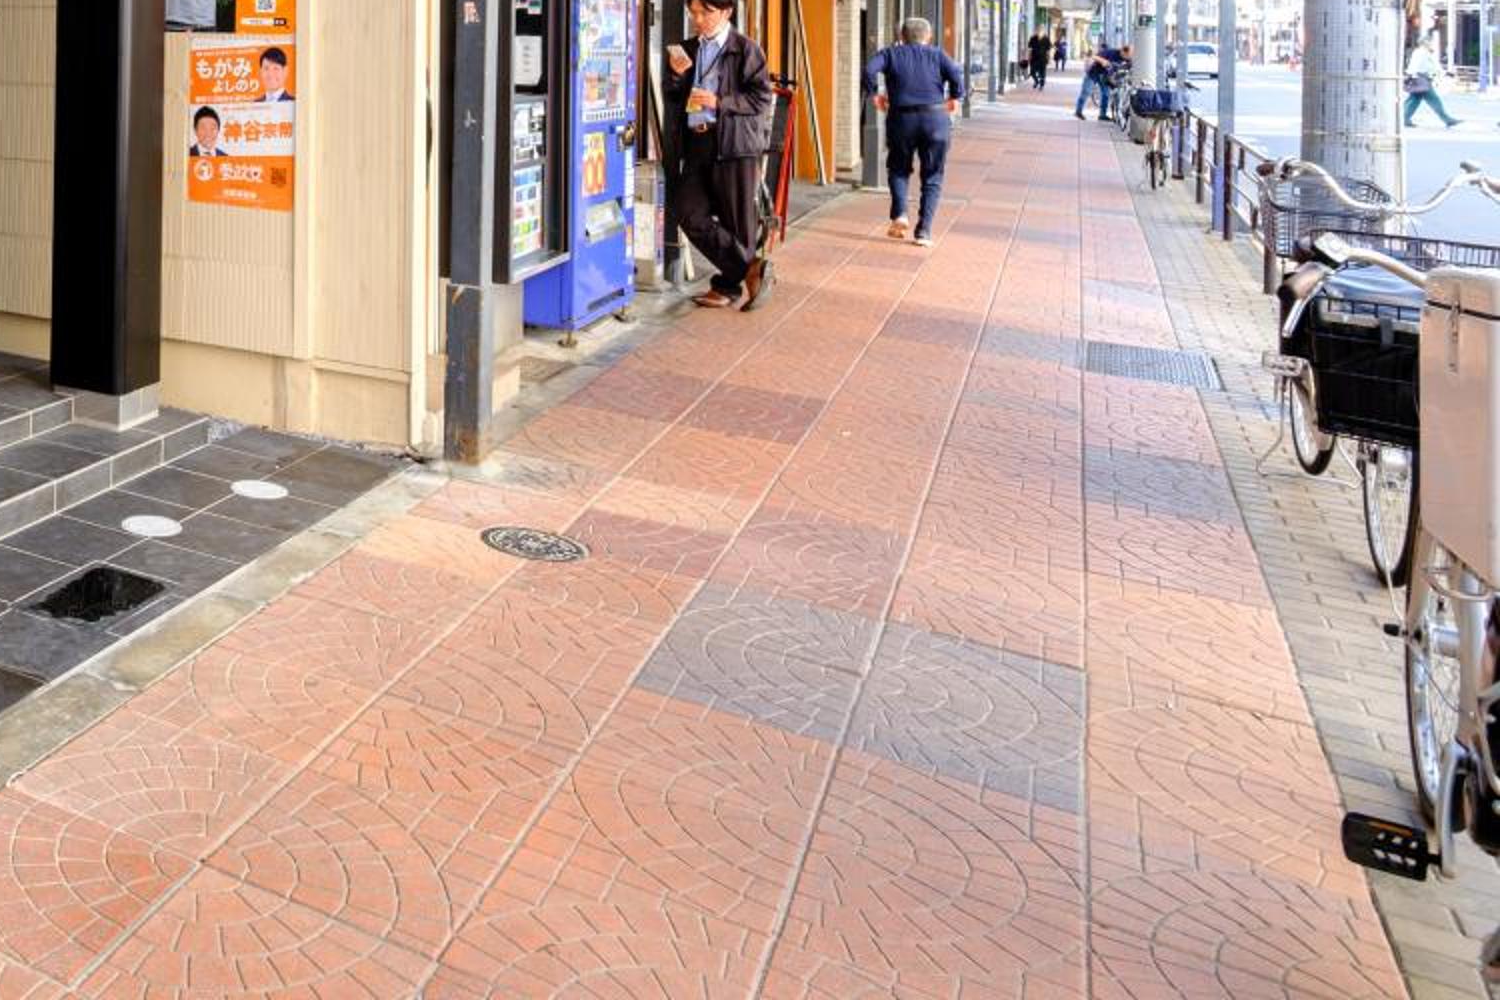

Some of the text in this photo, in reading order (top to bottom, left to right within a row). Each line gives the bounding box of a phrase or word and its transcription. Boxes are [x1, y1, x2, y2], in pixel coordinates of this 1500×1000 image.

[196, 57, 252, 80] もがみ
[212, 79, 260, 93] よしのり
